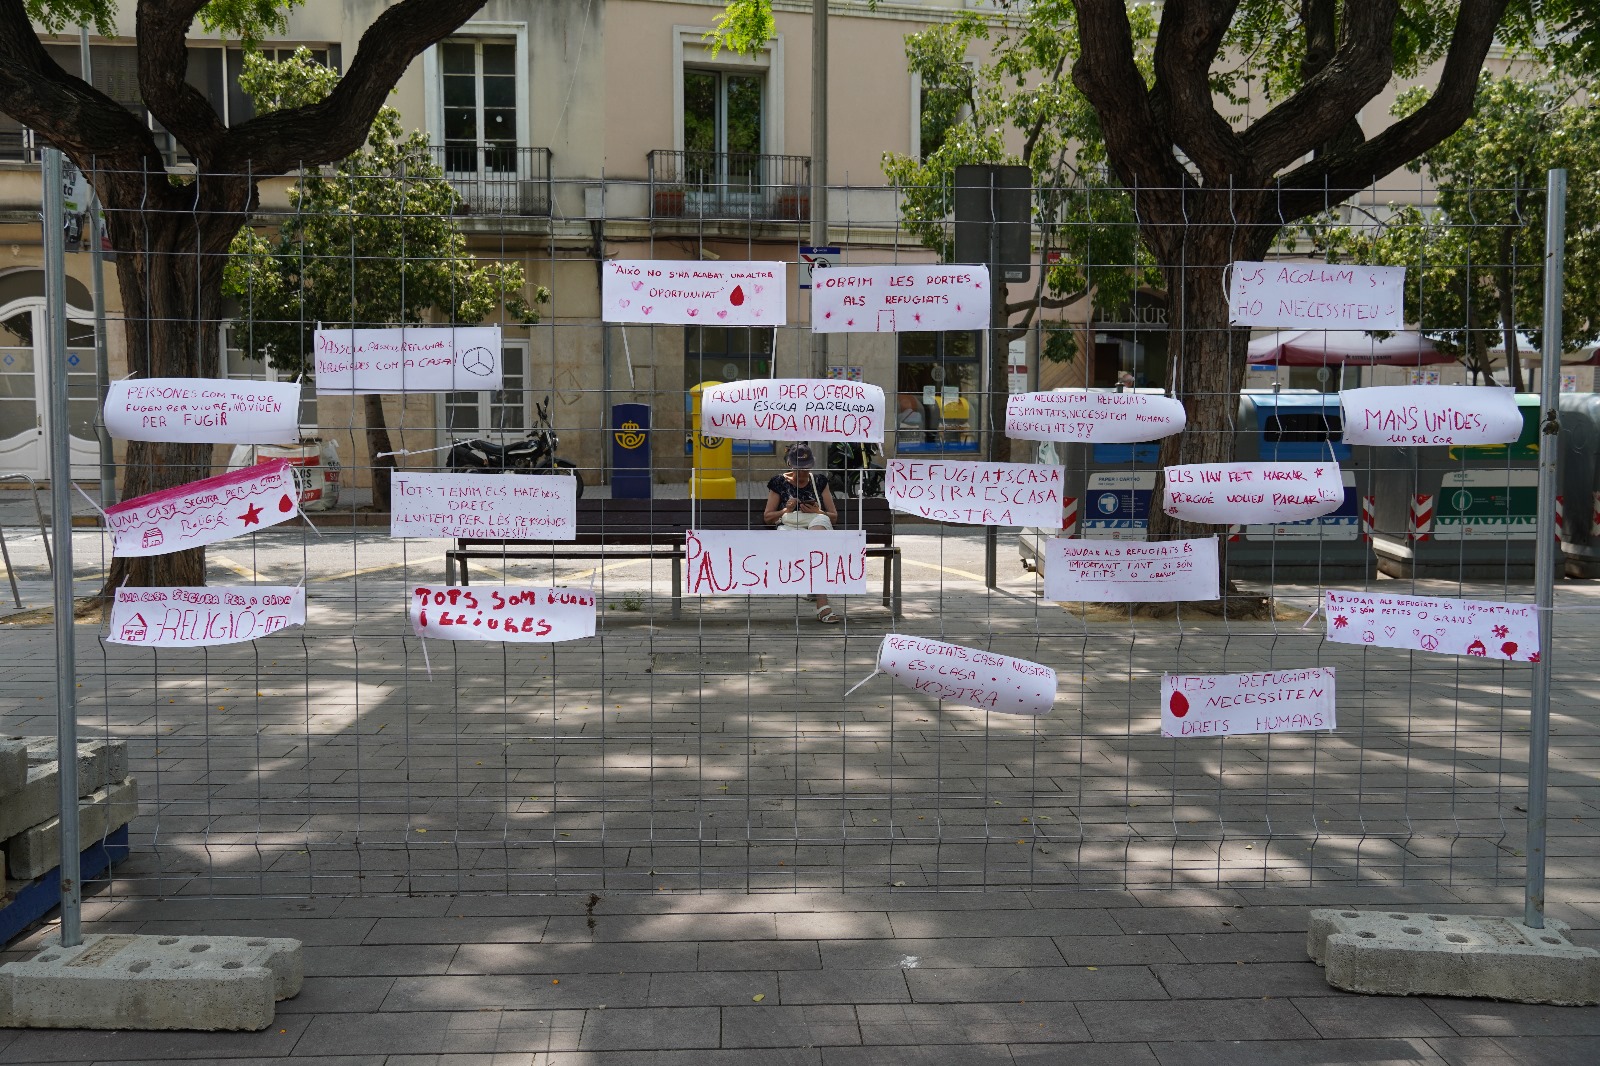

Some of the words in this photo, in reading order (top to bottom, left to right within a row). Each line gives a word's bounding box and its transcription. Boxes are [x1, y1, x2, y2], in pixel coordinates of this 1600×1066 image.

[826, 277, 872, 287] OBRIM
[890, 276, 913, 286] LES
[843, 296, 865, 306] ALS
[886, 295, 948, 304] REFUGIATS
[1238, 299, 1262, 316] HO
[376, 361, 398, 370] COM
[404, 359, 414, 368] A
[128, 387, 197, 399] PERSONES
[247, 394, 274, 402] QUE
[712, 387, 768, 403] ACOLLIM
[779, 385, 807, 399] PER
[813, 384, 865, 400] OFERIR
[1012, 394, 1025, 402] NO
[126, 403, 162, 412] FUGEN
[754, 401, 797, 412] ESCOLA
[806, 402, 874, 412] PARELLADA
[143, 416, 167, 427] PER
[712, 414, 746, 429] UNA
[754, 412, 798, 431] VIDA
[803, 414, 872, 438] MILLOR
[1364, 406, 1418, 431] MANS
[1016, 468, 1059, 484] CASA
[1169, 470, 1193, 483] ELS
[1228, 471, 1252, 482] FET
[1263, 469, 1307, 481] MARXAR
[486, 487, 506, 496] ELS
[985, 487, 1009, 503] ES
[1013, 489, 1058, 504] CASA
[147, 504, 177, 518] CASA
[184, 494, 219, 509] SEGURA
[226, 486, 245, 497] PER
[448, 500, 494, 511] DRETS
[459, 514, 484, 525] PER
[920, 506, 1012, 524] VOSTRA
[778, 559, 805, 583] US
[141, 592, 168, 601] CASA
[173, 589, 219, 604] SEGURA
[224, 593, 246, 605] PER
[415, 588, 478, 609] TOTS
[1418, 611, 1427, 619] O
[939, 665, 975, 680] CASA
[973, 653, 1004, 667] CASA
[1012, 661, 1051, 678] NOSTRA
[915, 676, 997, 706] VOSTRA
[1181, 719, 1230, 735] DRETS
[1256, 713, 1323, 731] HUMANS
